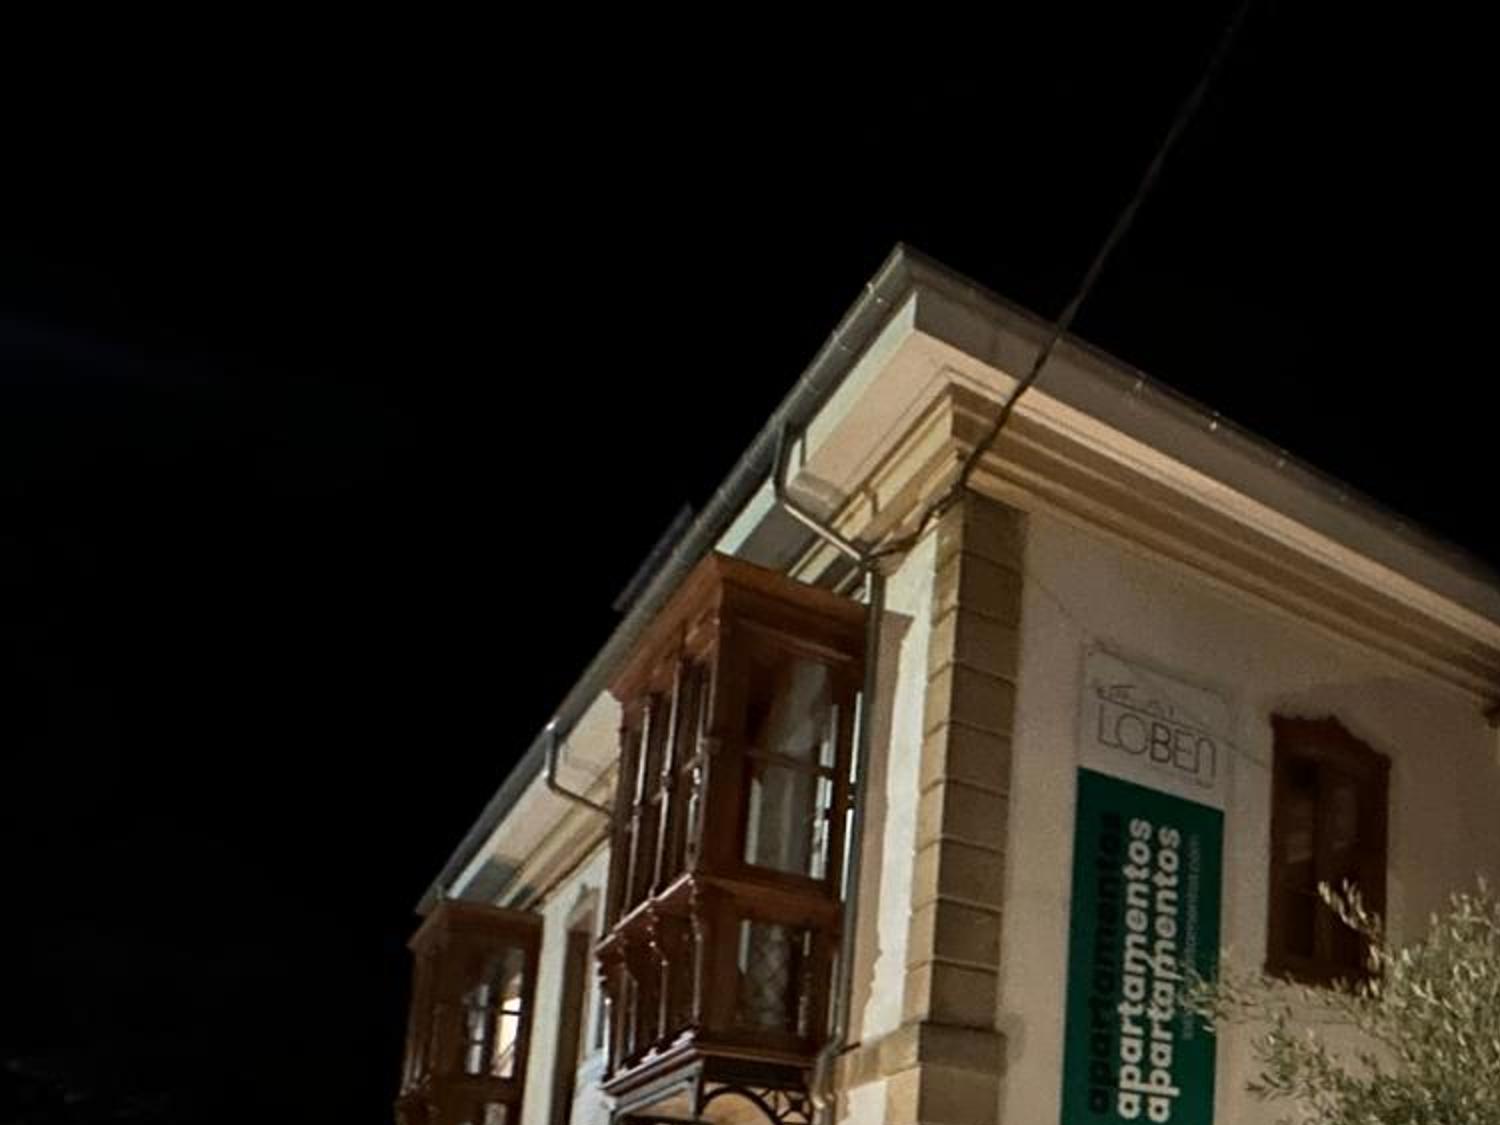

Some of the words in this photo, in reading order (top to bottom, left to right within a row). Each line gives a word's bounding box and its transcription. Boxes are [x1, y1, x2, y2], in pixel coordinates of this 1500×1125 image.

[1087, 811, 1121, 1115] apartamentos
[1116, 817, 1152, 1121] apartamentos
[1147, 826, 1181, 1125] apartamentos
